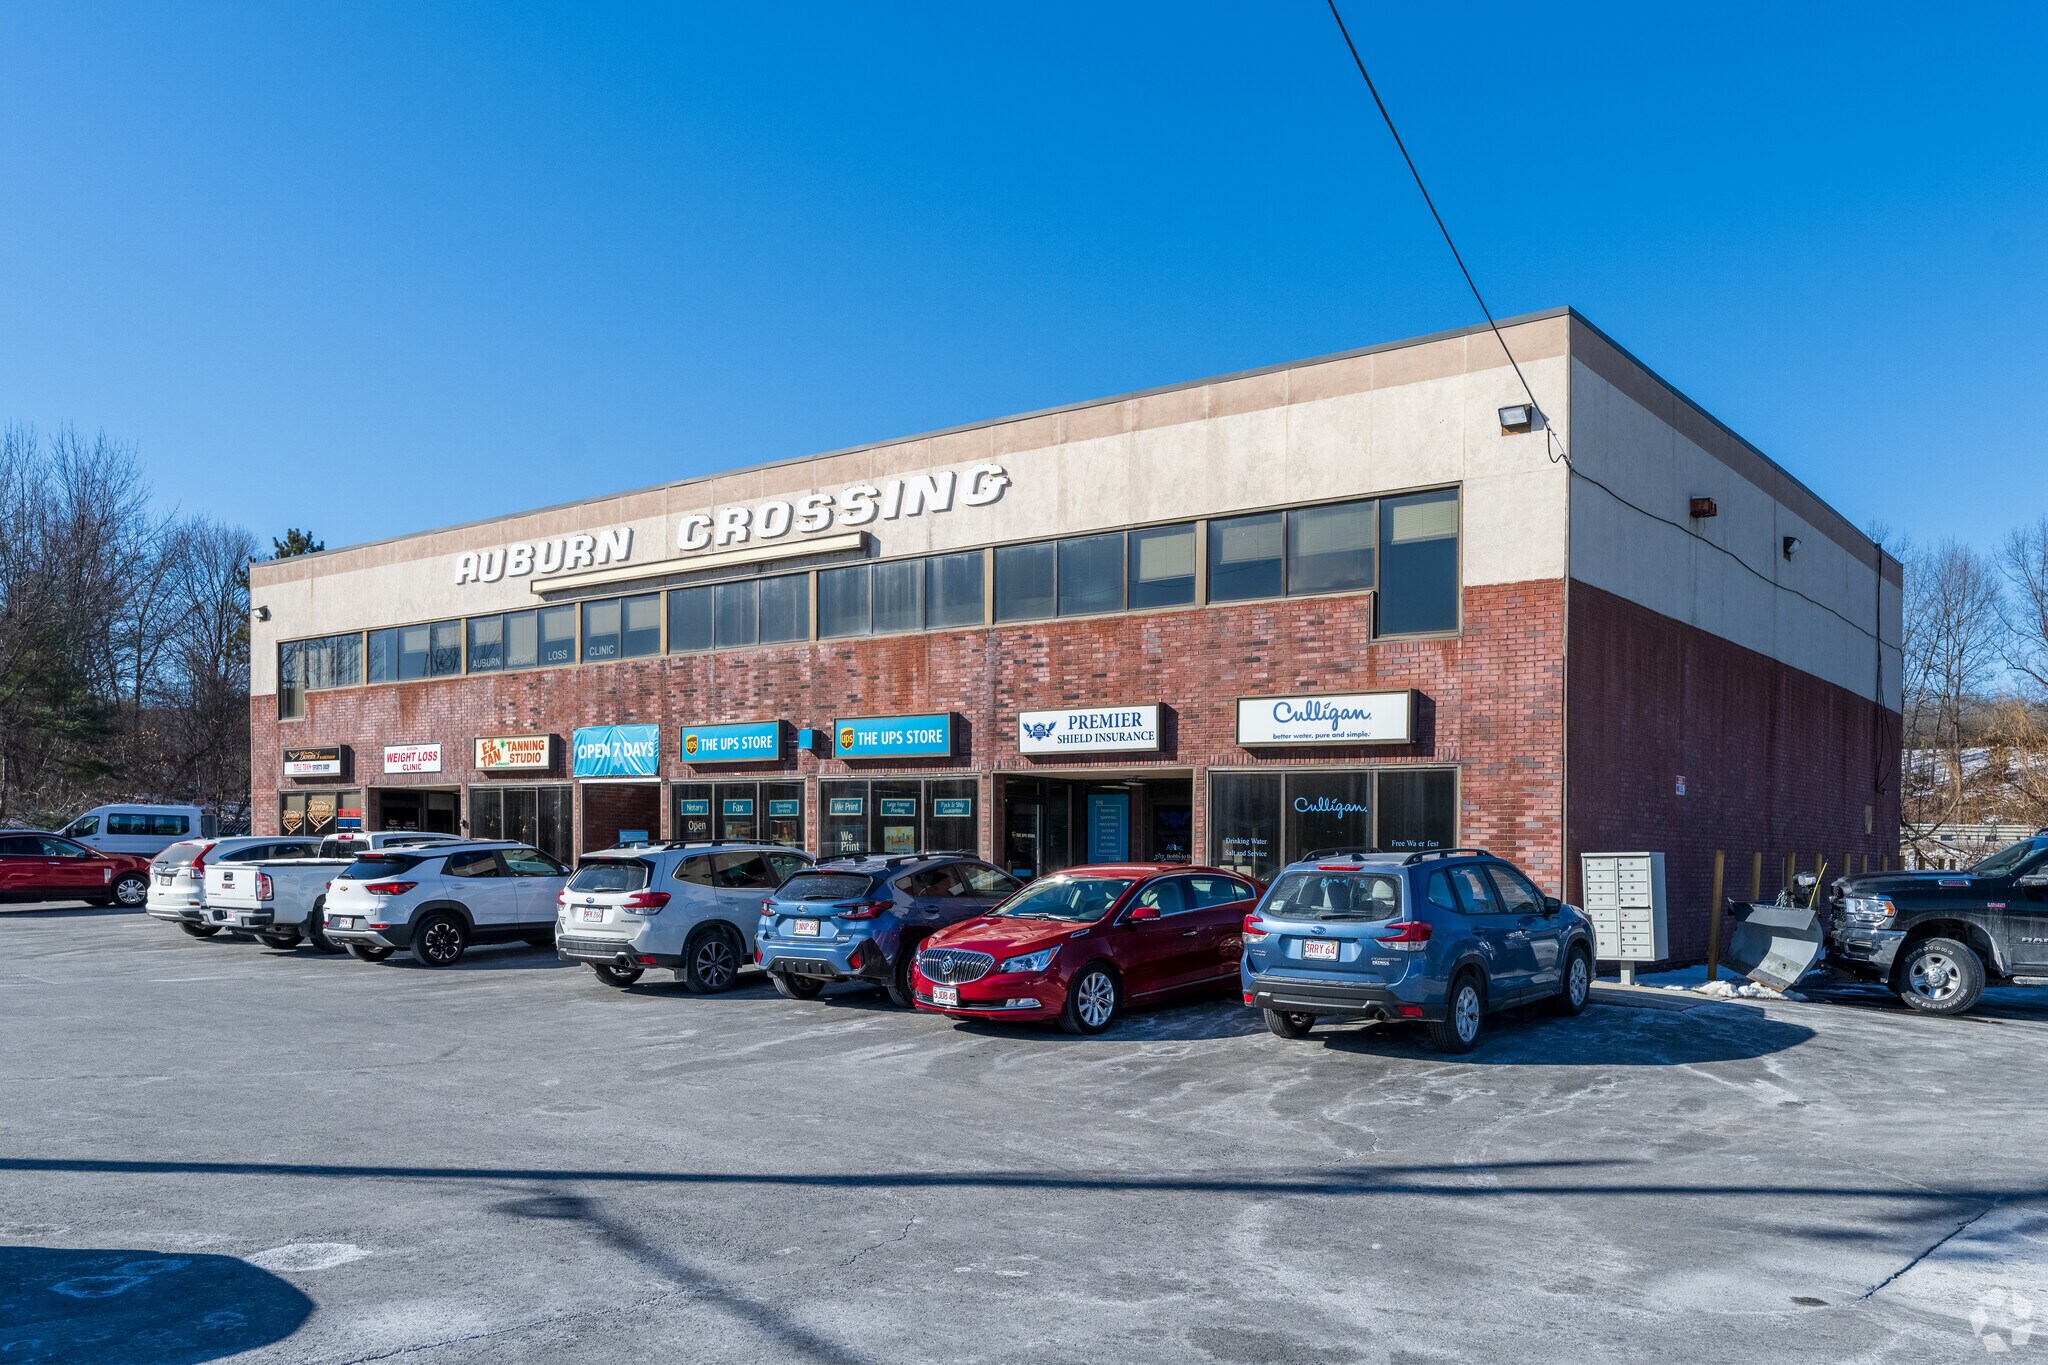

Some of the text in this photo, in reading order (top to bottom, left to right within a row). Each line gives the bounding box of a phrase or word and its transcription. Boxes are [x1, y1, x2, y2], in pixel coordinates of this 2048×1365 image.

[454, 463, 1012, 585] AUBURN CROSSING
[472, 656, 500, 669] AUBURN
[547, 649, 568, 661] LOSS
[589, 644, 615, 657] CLINIC
[1068, 711, 1143, 730] PREMIER
[1273, 699, 1371, 732] Culligan
[857, 729, 943, 746] THE UPS STORE
[1057, 733, 1093, 744] SHIELD
[1095, 730, 1155, 743] INSURANCE
[1272, 732, 1292, 740] better
[1315, 732, 1331, 740] pure
[506, 740, 545, 752] TANNING
[701, 735, 772, 751] THE UPS STORE
[577, 742, 654, 759] OPEN 7 DAYS
[387, 751, 438, 763] WEIGHT LOSS
[481, 748, 501, 768] TAN
[509, 752, 541, 763] STUDIO
[687, 804, 704, 812] Notary
[732, 803, 744, 812] Fax
[834, 802, 859, 811] We Print
[688, 820, 707, 832] Open
[841, 831, 853, 841] We
[1225, 837, 1250, 846] Drinking
[841, 841, 859, 852] Print
[1305, 943, 1335, 955] 3RRY 64
